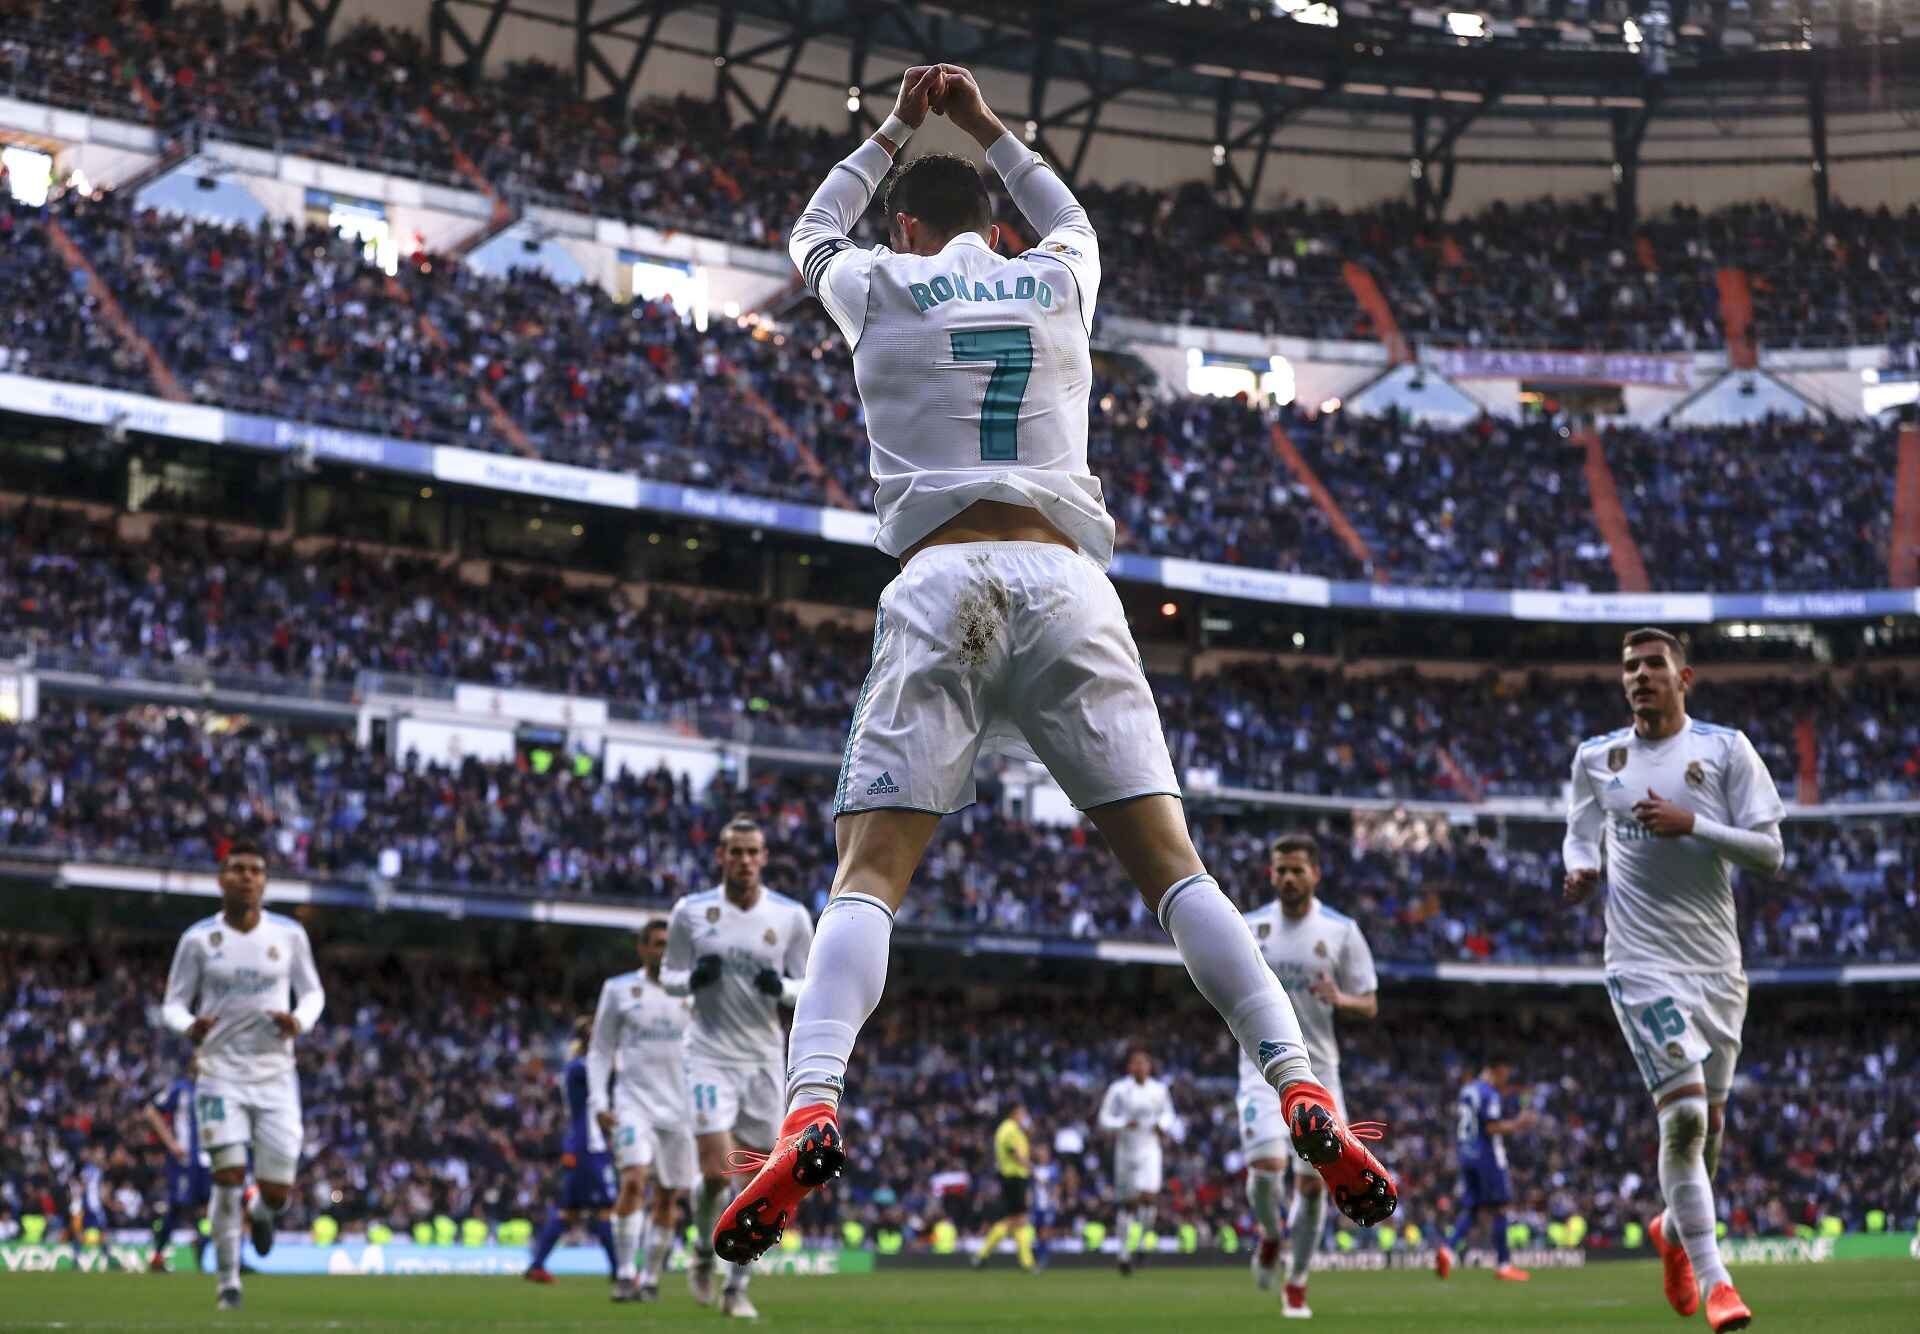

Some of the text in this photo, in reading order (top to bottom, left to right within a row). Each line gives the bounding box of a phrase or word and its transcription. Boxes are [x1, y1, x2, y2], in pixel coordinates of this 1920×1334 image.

[908, 272, 1053, 313] RONALDO
[950, 326, 1033, 461] 7
[866, 784, 900, 796] adidas
[1640, 995, 1686, 1047] 15
[694, 1083, 718, 1110] 11
